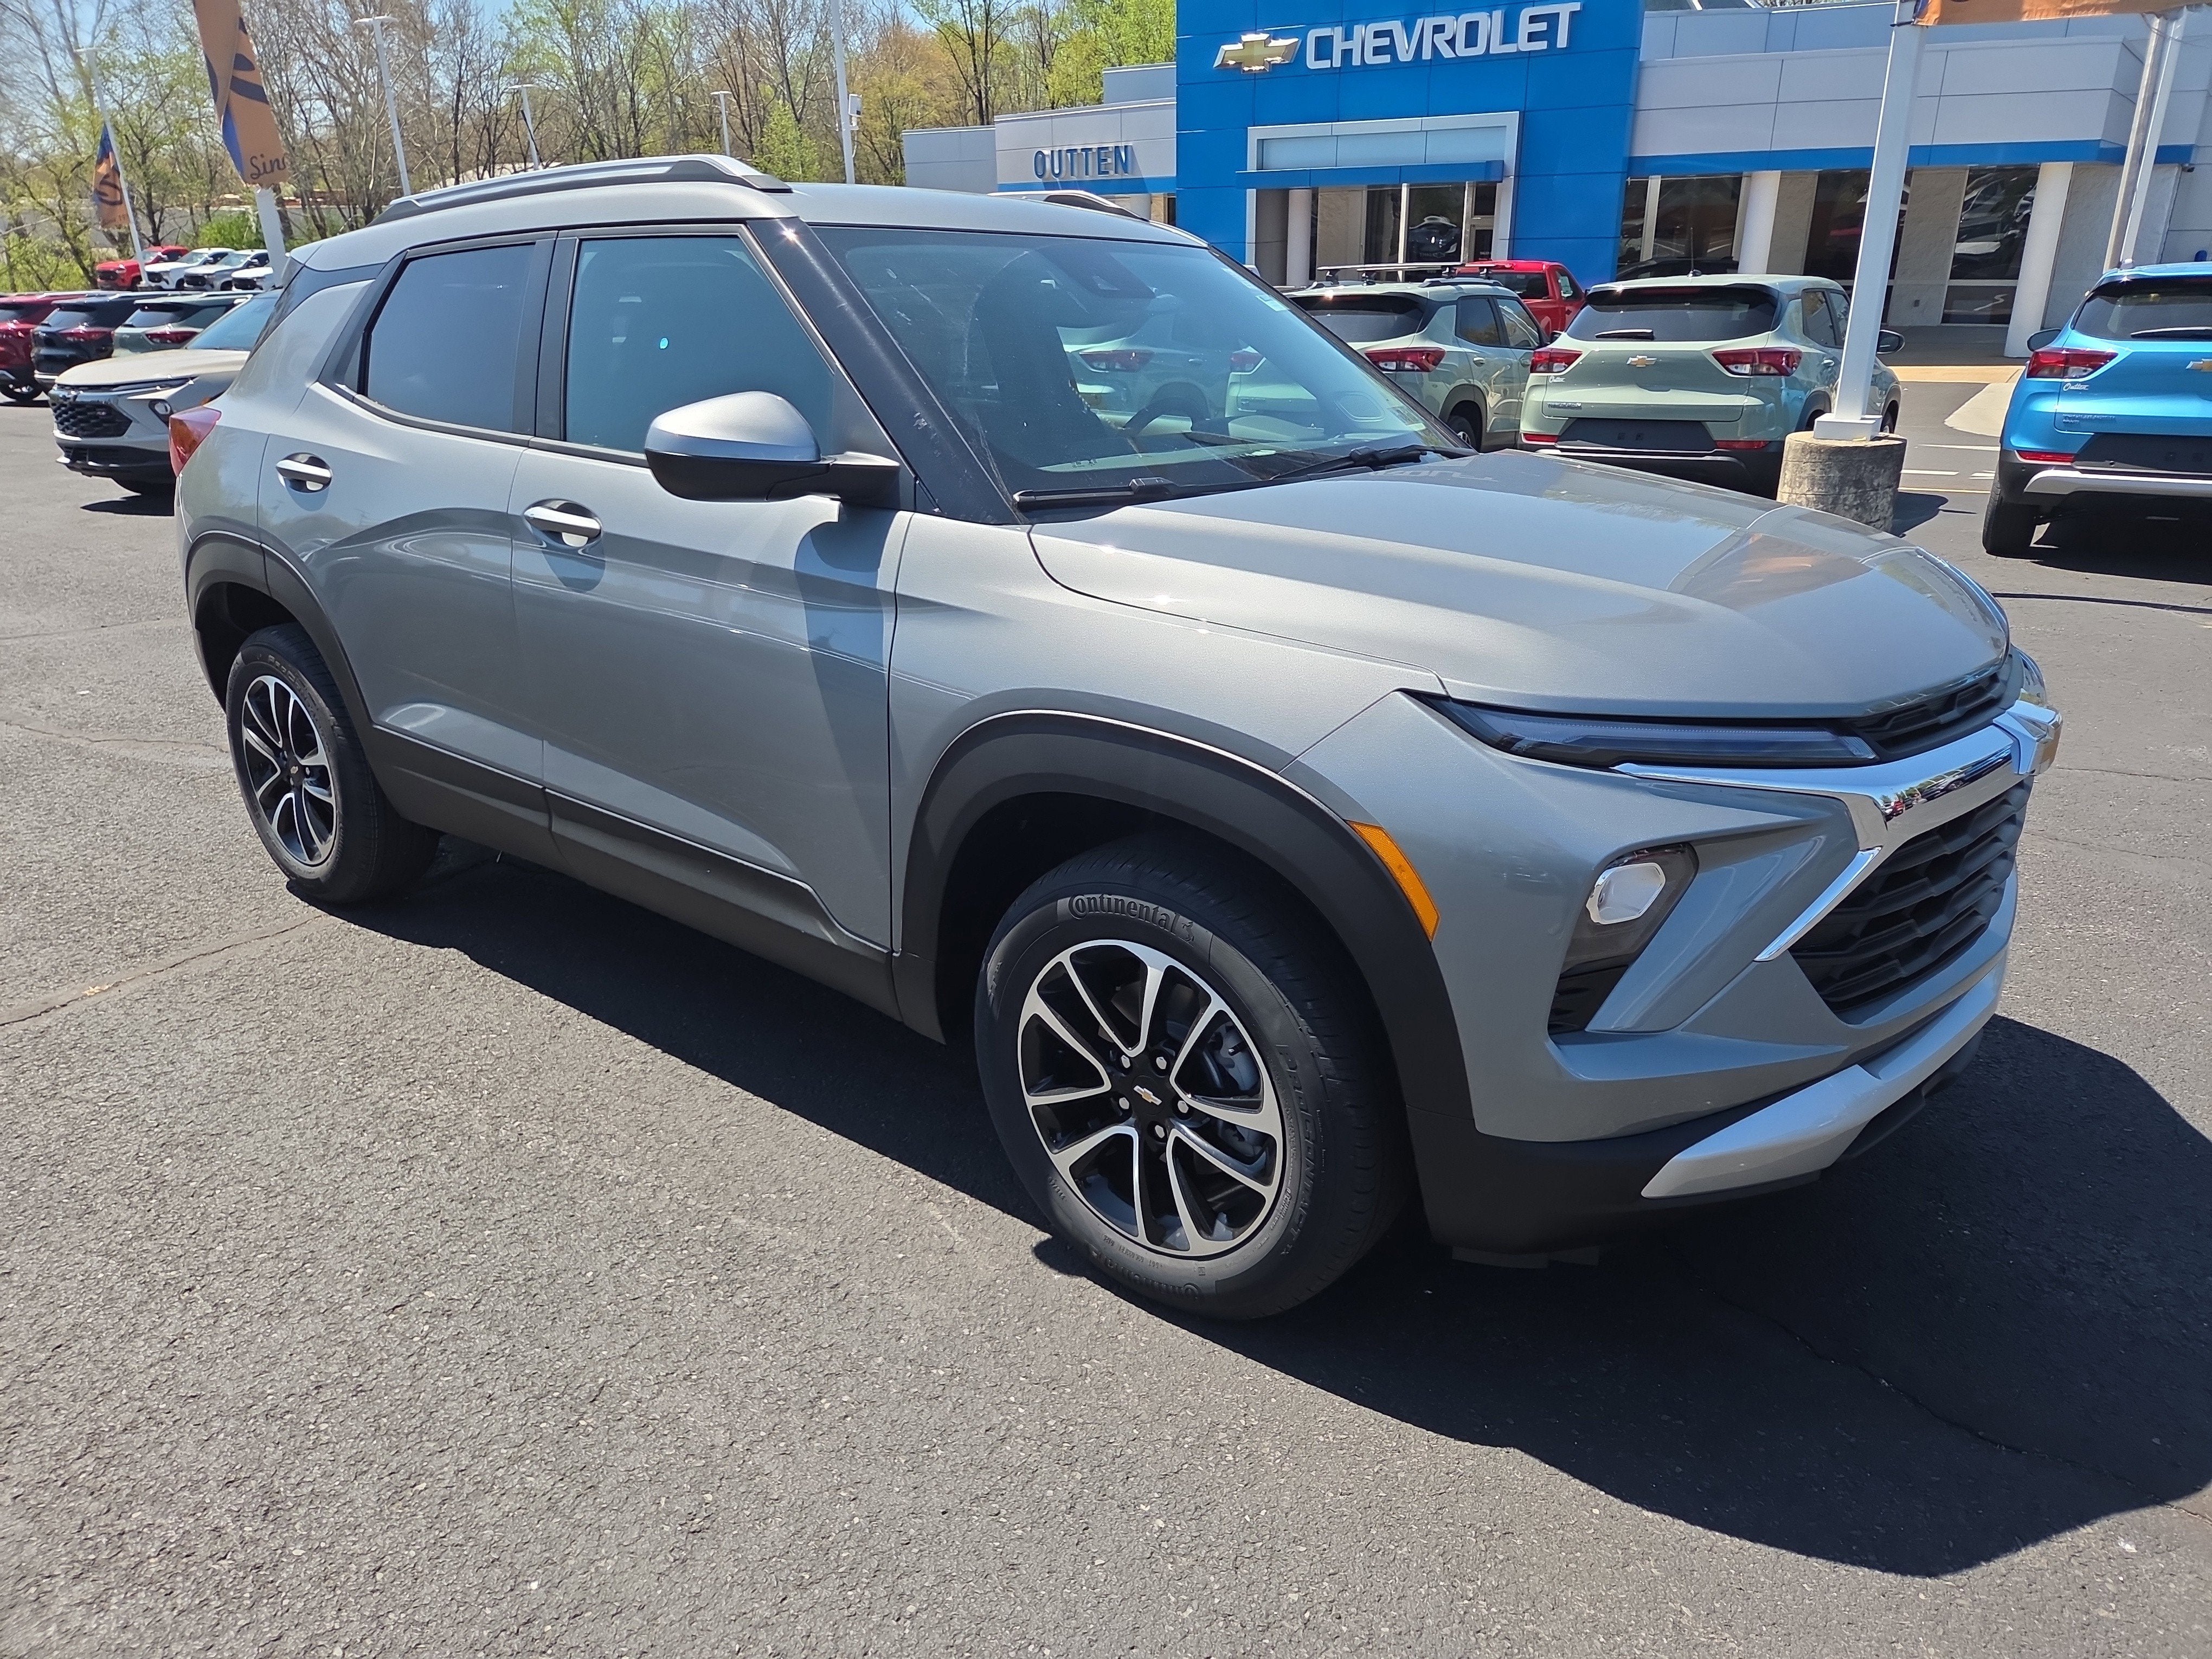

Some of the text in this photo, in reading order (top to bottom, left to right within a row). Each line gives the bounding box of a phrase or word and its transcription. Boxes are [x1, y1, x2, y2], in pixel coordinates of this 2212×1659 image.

[1306, 2, 1581, 69] CHEVROLET
[1034, 145, 1133, 179] OUTTEN
[1068, 894, 1180, 935] Continental
